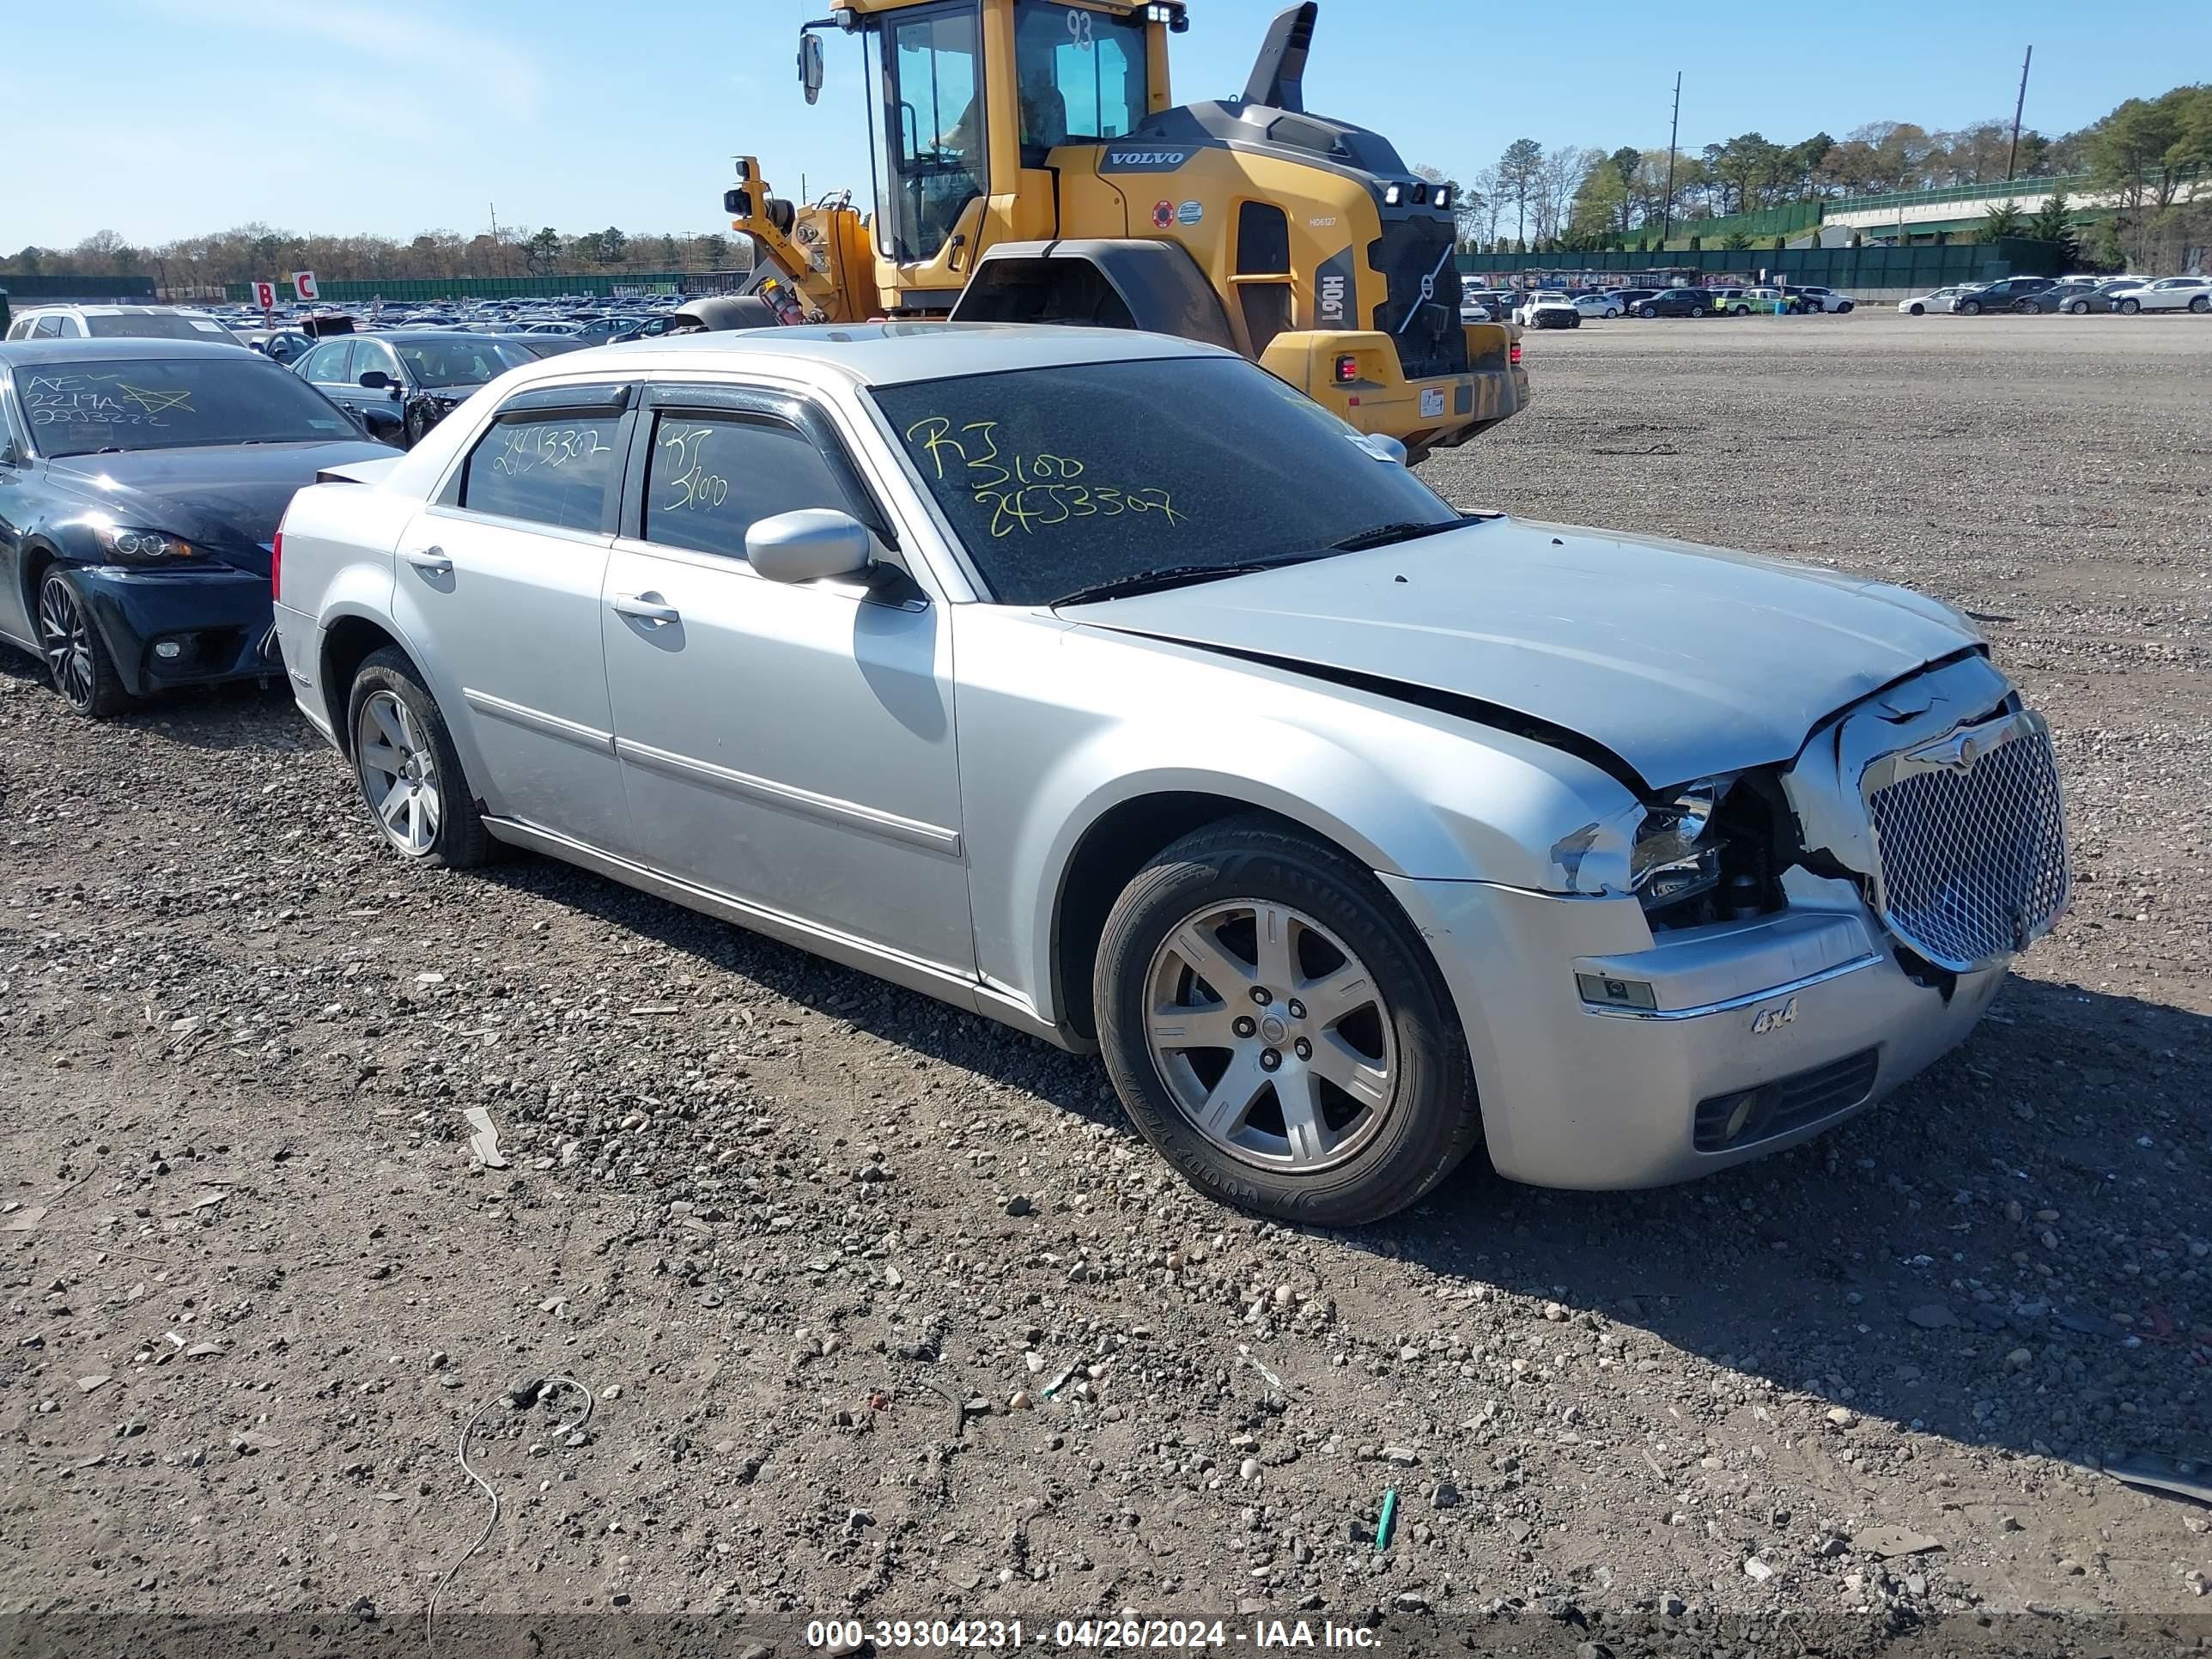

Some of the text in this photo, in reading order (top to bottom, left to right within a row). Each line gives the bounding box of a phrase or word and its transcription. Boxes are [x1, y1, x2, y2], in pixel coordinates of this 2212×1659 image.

[1066, 9, 1092, 52] 93
[1111, 153, 1184, 164] VOLVO
[1310, 218, 1337, 227] H06127
[258, 284, 273, 307] B
[298, 274, 314, 298] C
[1322, 276, 1345, 320] L90H
[24, 392, 125, 413] 2219A
[1752, 997, 1798, 1035] 4x4
